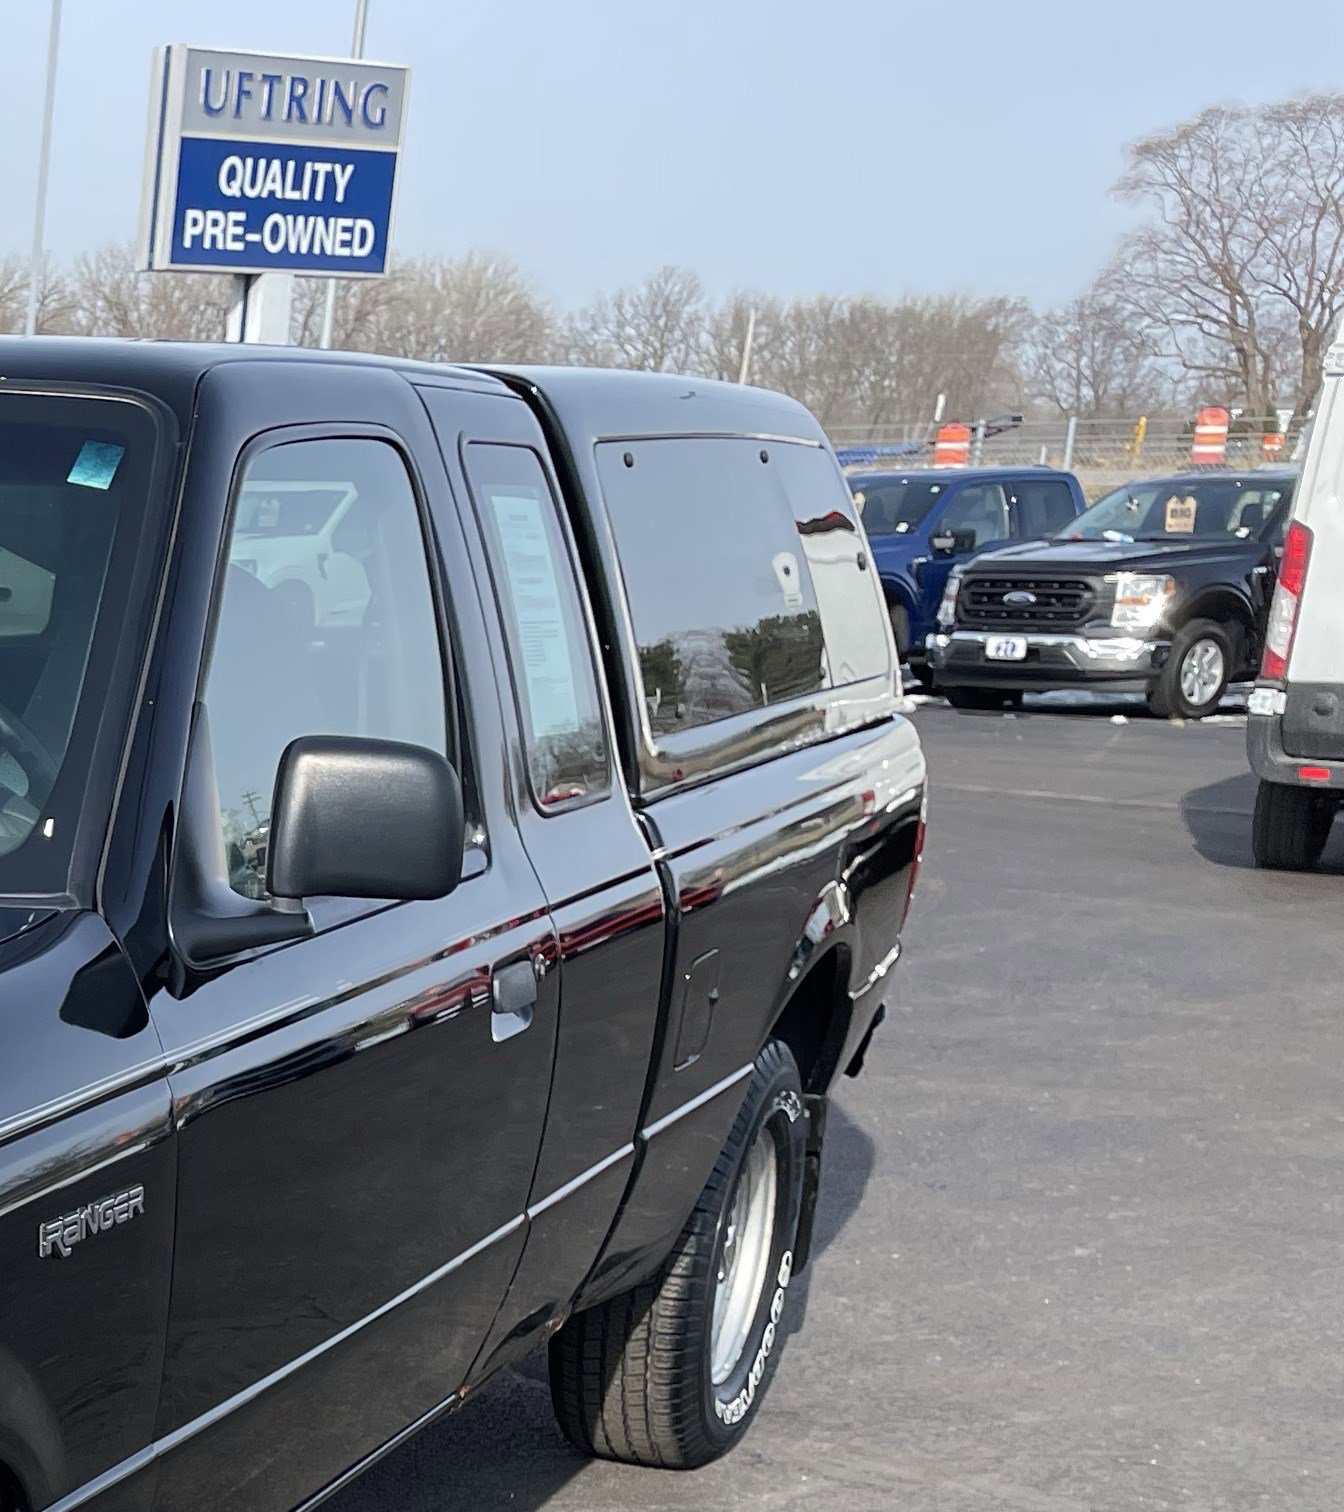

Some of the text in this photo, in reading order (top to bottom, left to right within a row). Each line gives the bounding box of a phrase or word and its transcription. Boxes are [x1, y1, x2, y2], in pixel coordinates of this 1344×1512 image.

[199, 67, 390, 131] UFTRING
[218, 155, 355, 203] QUALITY
[182, 208, 376, 258] PRE-OWNED
[38, 1183, 145, 1258] RANGER
